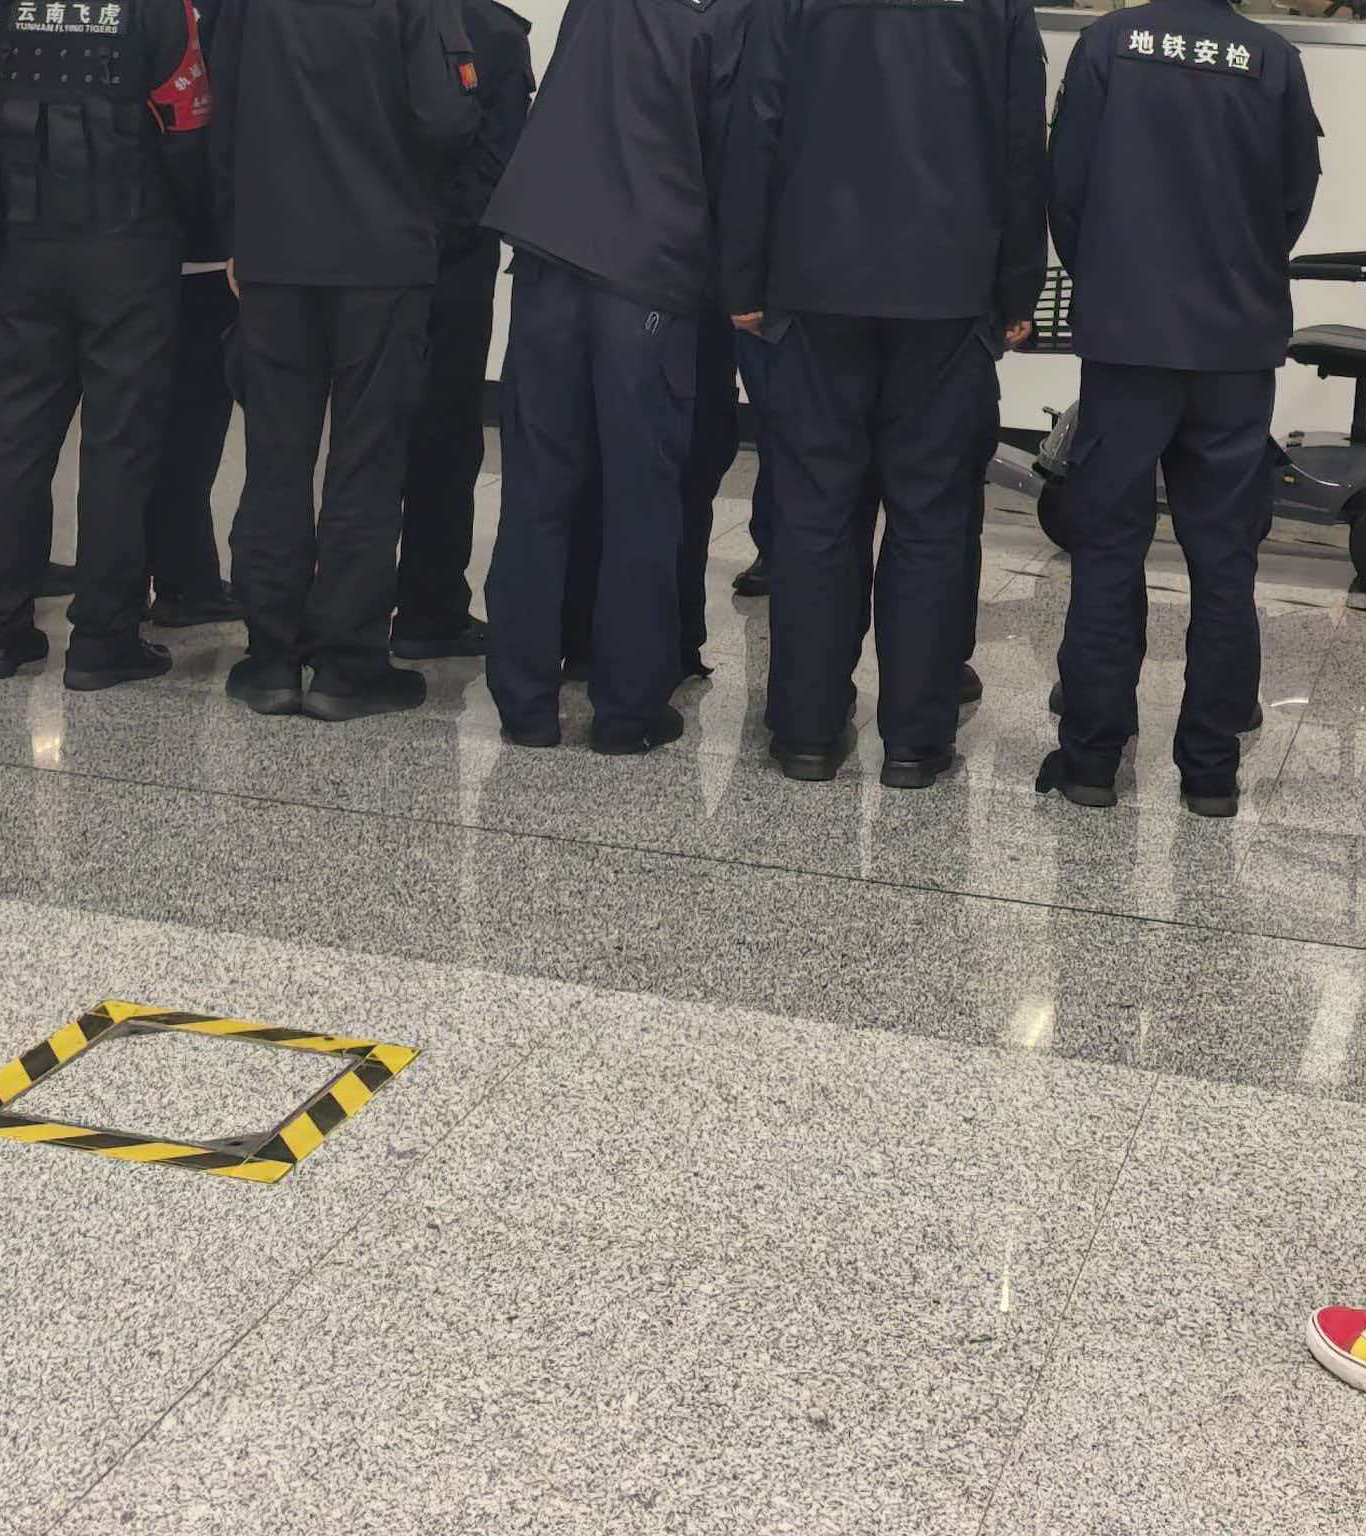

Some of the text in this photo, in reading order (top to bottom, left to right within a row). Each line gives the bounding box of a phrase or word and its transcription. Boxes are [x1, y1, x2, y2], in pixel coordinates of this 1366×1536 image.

[17, 1, 122, 26] 云南飞虎
[15, 22, 54, 32] YUNNAN
[85, 24, 118, 34] TIGERS
[1128, 29, 1252, 71] 地铁安检
